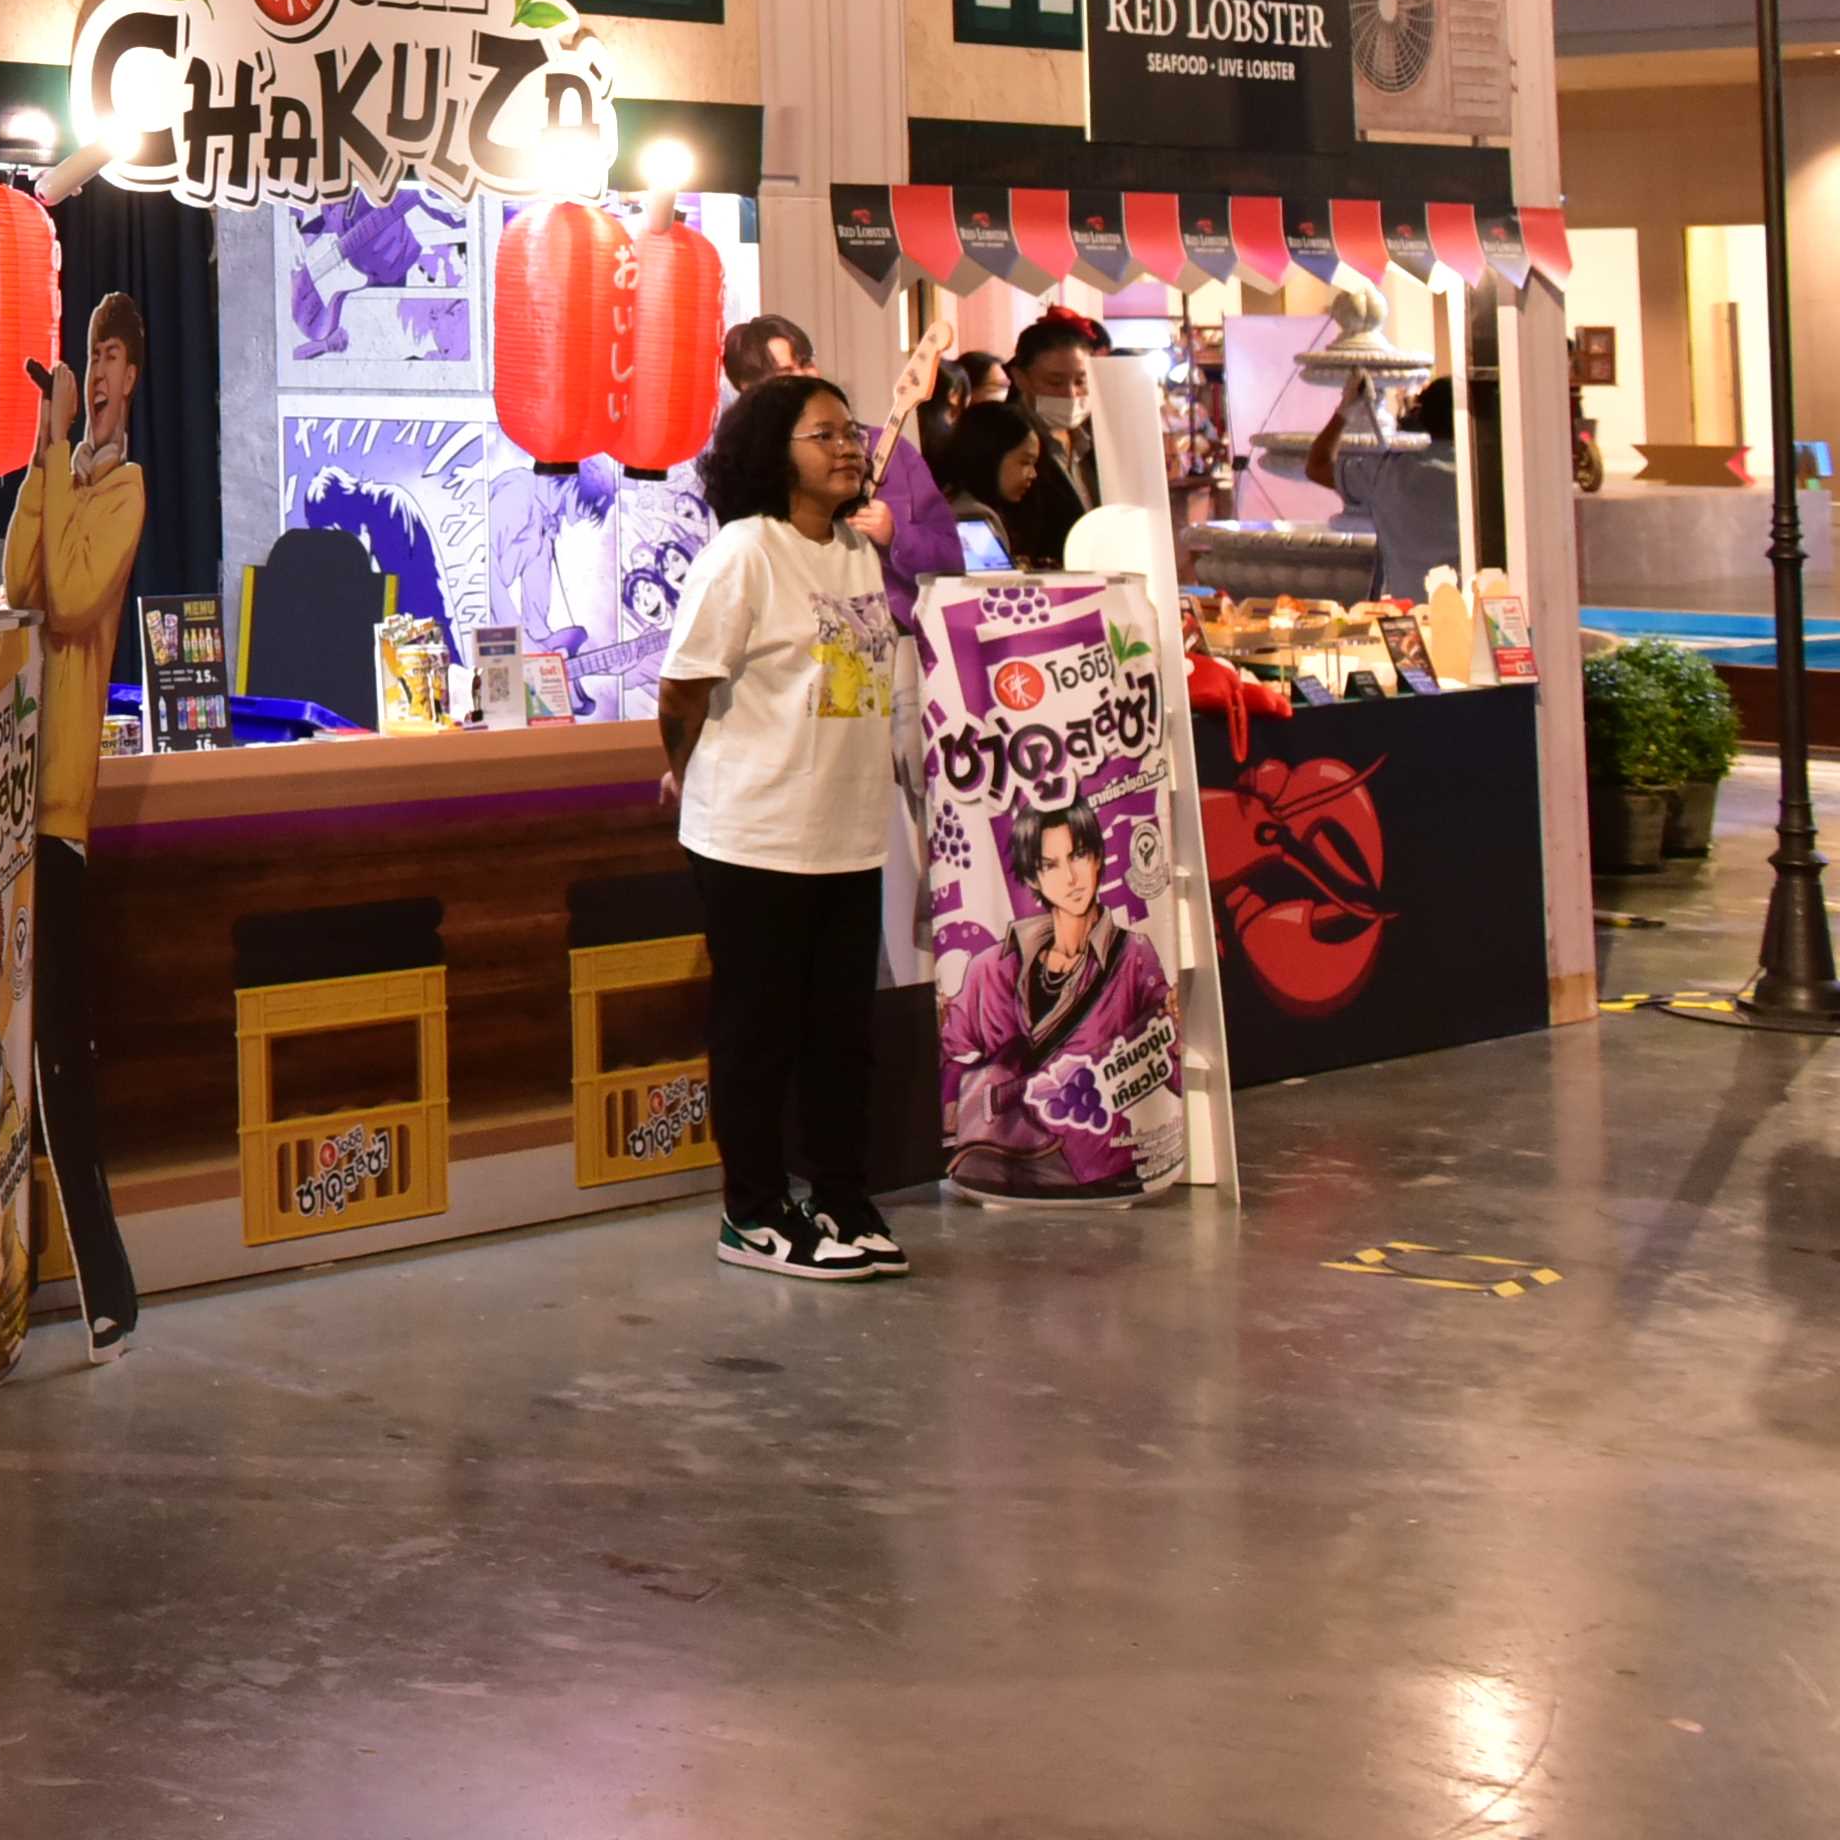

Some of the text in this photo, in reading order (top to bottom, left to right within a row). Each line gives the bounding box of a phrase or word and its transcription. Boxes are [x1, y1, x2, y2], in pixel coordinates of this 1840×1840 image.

[1146, 52, 1296, 81] SEAFOOD LIVE LOBSTER
